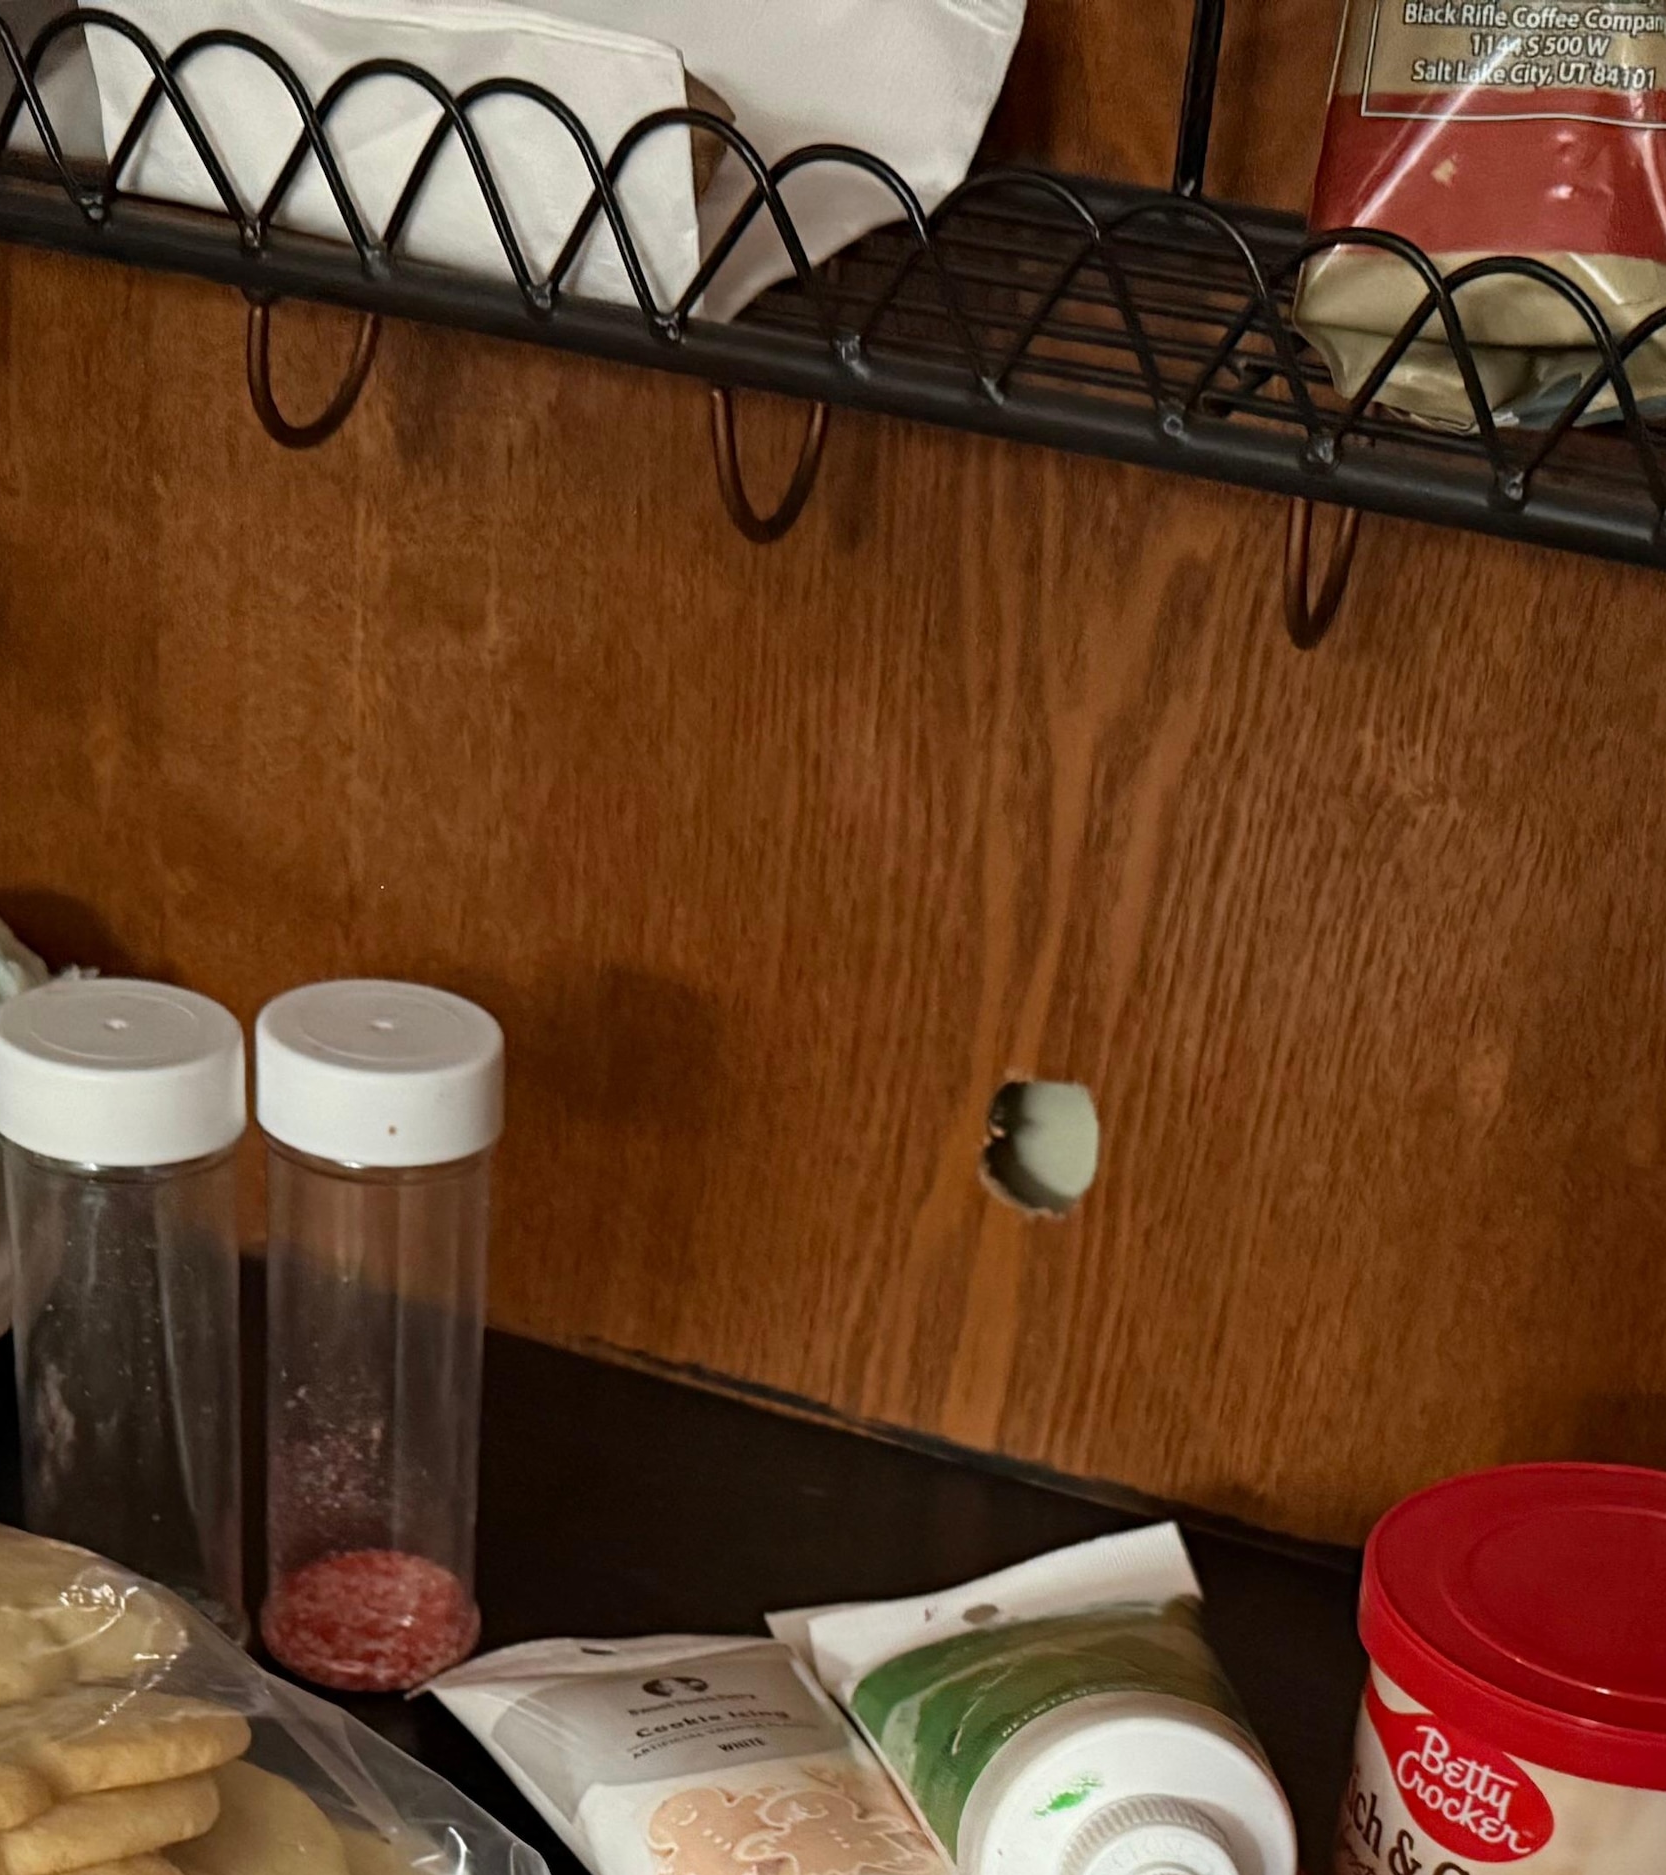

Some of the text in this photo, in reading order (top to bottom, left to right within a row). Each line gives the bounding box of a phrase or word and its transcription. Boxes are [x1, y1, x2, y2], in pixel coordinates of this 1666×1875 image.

[1403, 2, 1456, 26] Black
[1461, 5, 1507, 28] Rifle
[1512, 6, 1580, 29] Coffee
[1526, 36, 1542, 58] S
[1544, 36, 1582, 57] 500
[1586, 35, 1610, 58] W
[1412, 60, 1656, 91] Salt Lake City, UT 84101
[635, 1709, 790, 1739] Cookie Icing
[717, 1736, 767, 1753] WHITE
[1414, 1724, 1520, 1823] Betty
[1396, 1749, 1532, 1855] Crocker
